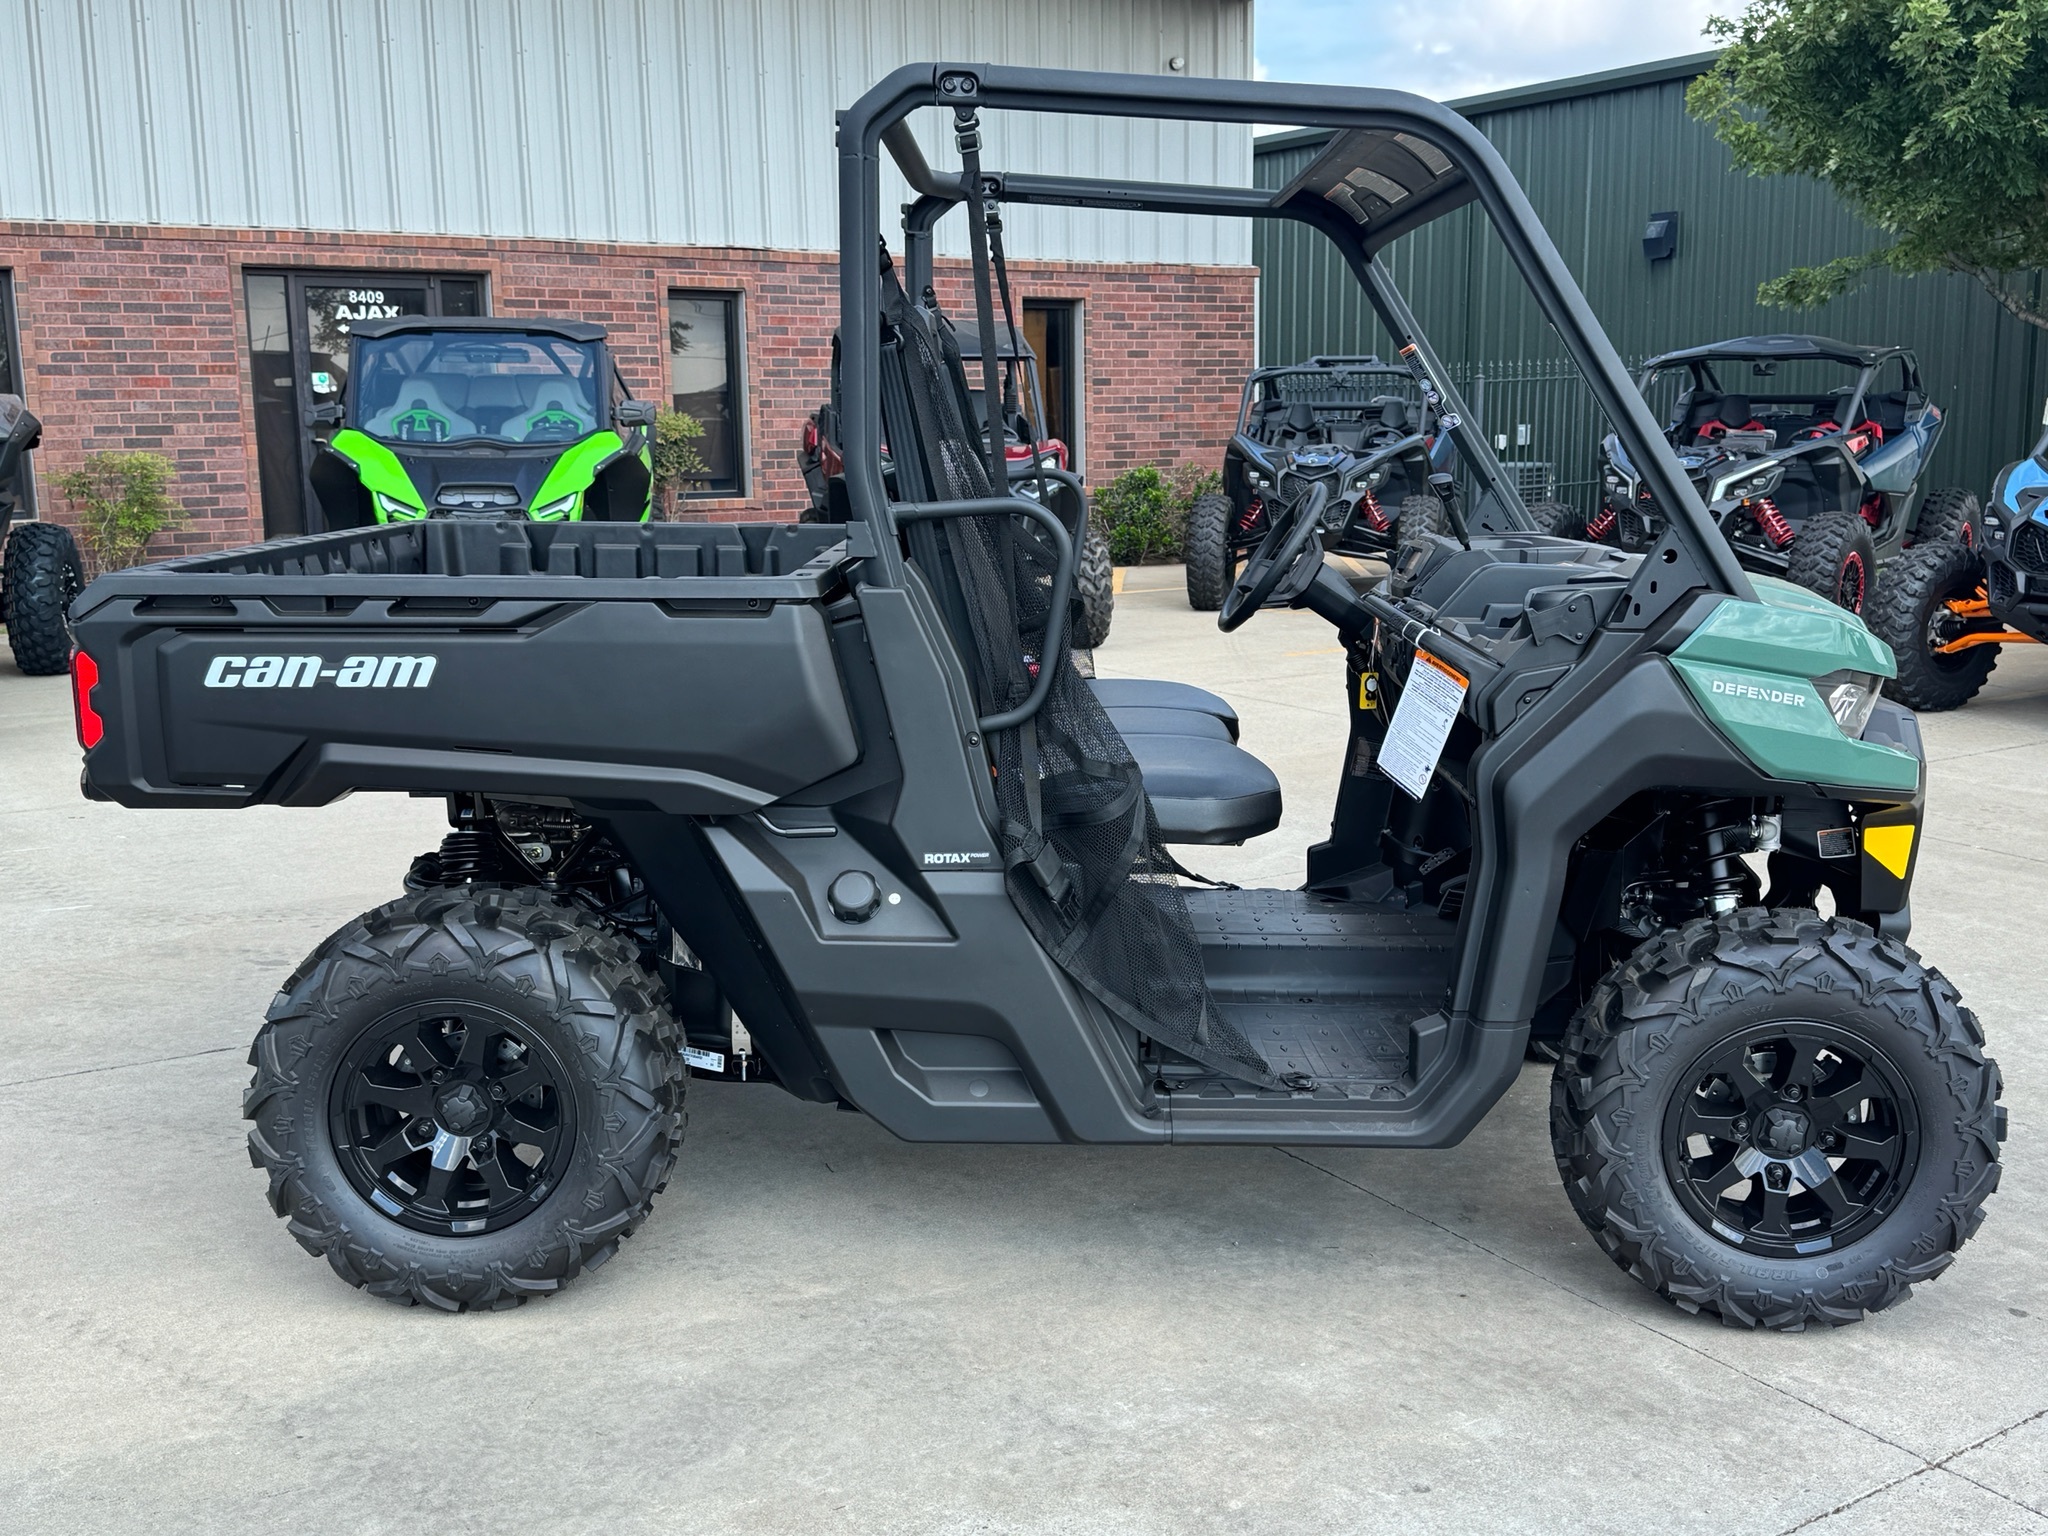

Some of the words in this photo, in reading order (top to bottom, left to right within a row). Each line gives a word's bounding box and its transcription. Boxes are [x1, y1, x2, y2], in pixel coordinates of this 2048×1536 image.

[348, 290, 384, 303] 8409
[335, 304, 399, 320] AJAX
[204, 655, 437, 688] can-am
[1712, 680, 1805, 707] DEFENDER
[924, 853, 970, 864] ROTAX
